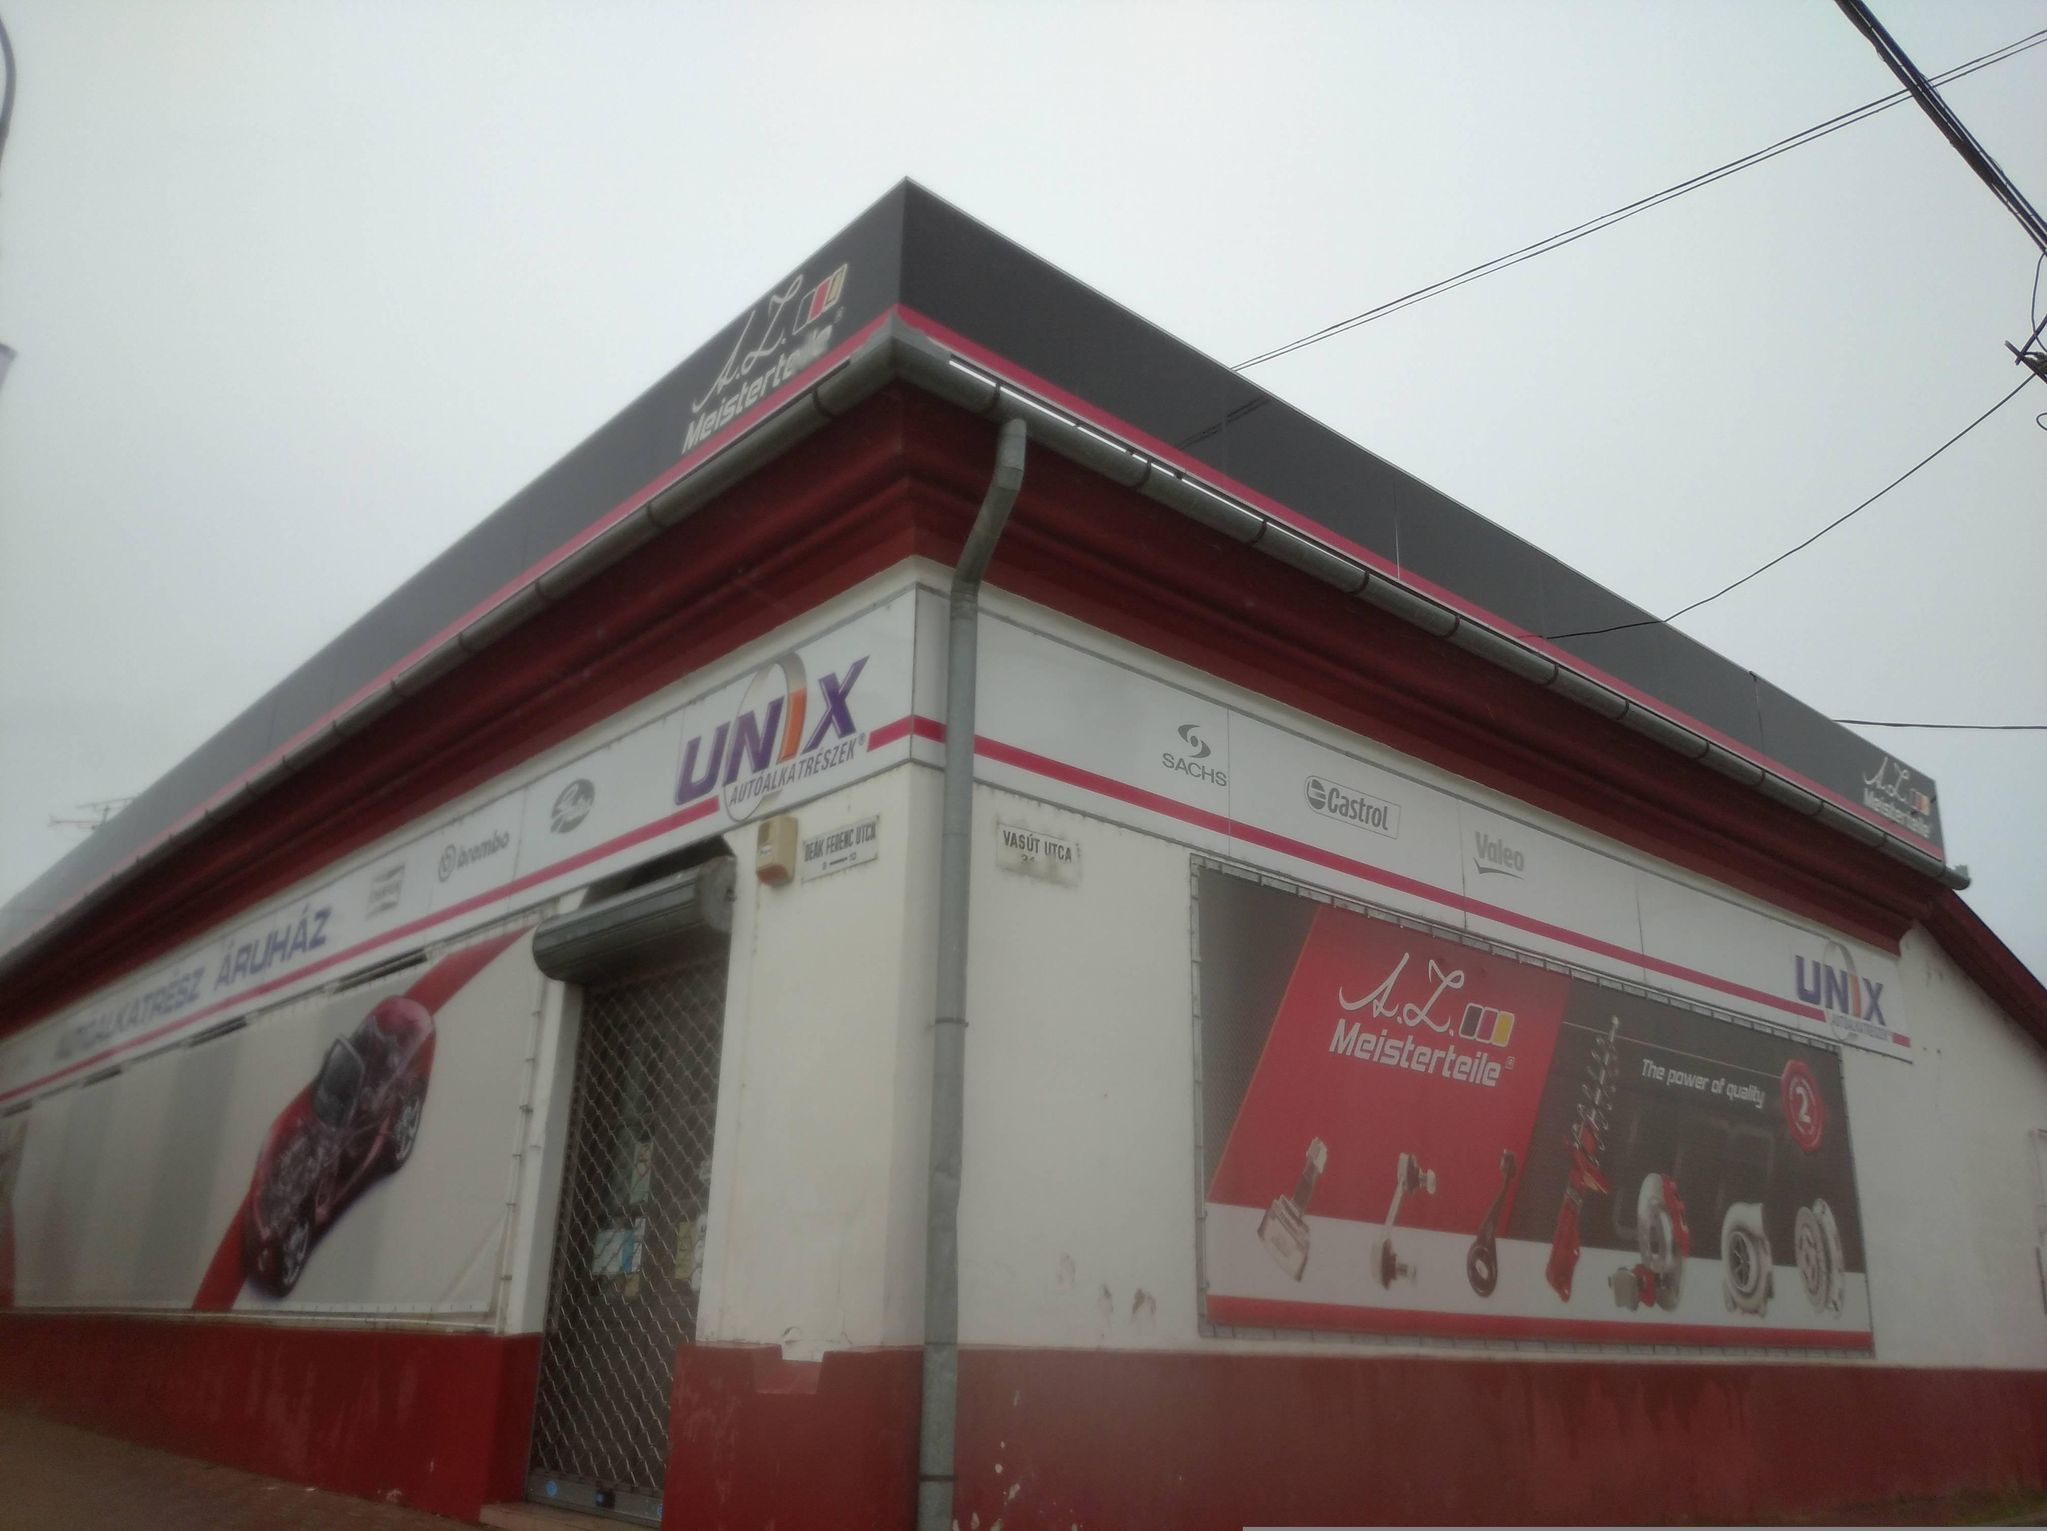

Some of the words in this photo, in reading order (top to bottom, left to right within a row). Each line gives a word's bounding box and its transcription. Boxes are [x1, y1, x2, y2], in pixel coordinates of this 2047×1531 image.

[676, 653, 870, 806] UNIX
[1162, 752, 1228, 788] SACHS
[1326, 787, 1388, 831] Castrol
[457, 829, 510, 868] brembo
[826, 828, 854, 855] FERENC
[855, 821, 876, 845] UTCA
[1003, 828, 1040, 854] VASÚT
[1044, 840, 1072, 863] UTCA
[213, 903, 334, 992] ÁRUHÁZ
[1795, 954, 1887, 1027] UNIX
[1329, 1018, 1502, 1087] Meisterteile
[1641, 1058, 1665, 1080] The
[1666, 1069, 1709, 1091] power
[1711, 1078, 1726, 1094] of
[1726, 1083, 1766, 1109] quality
